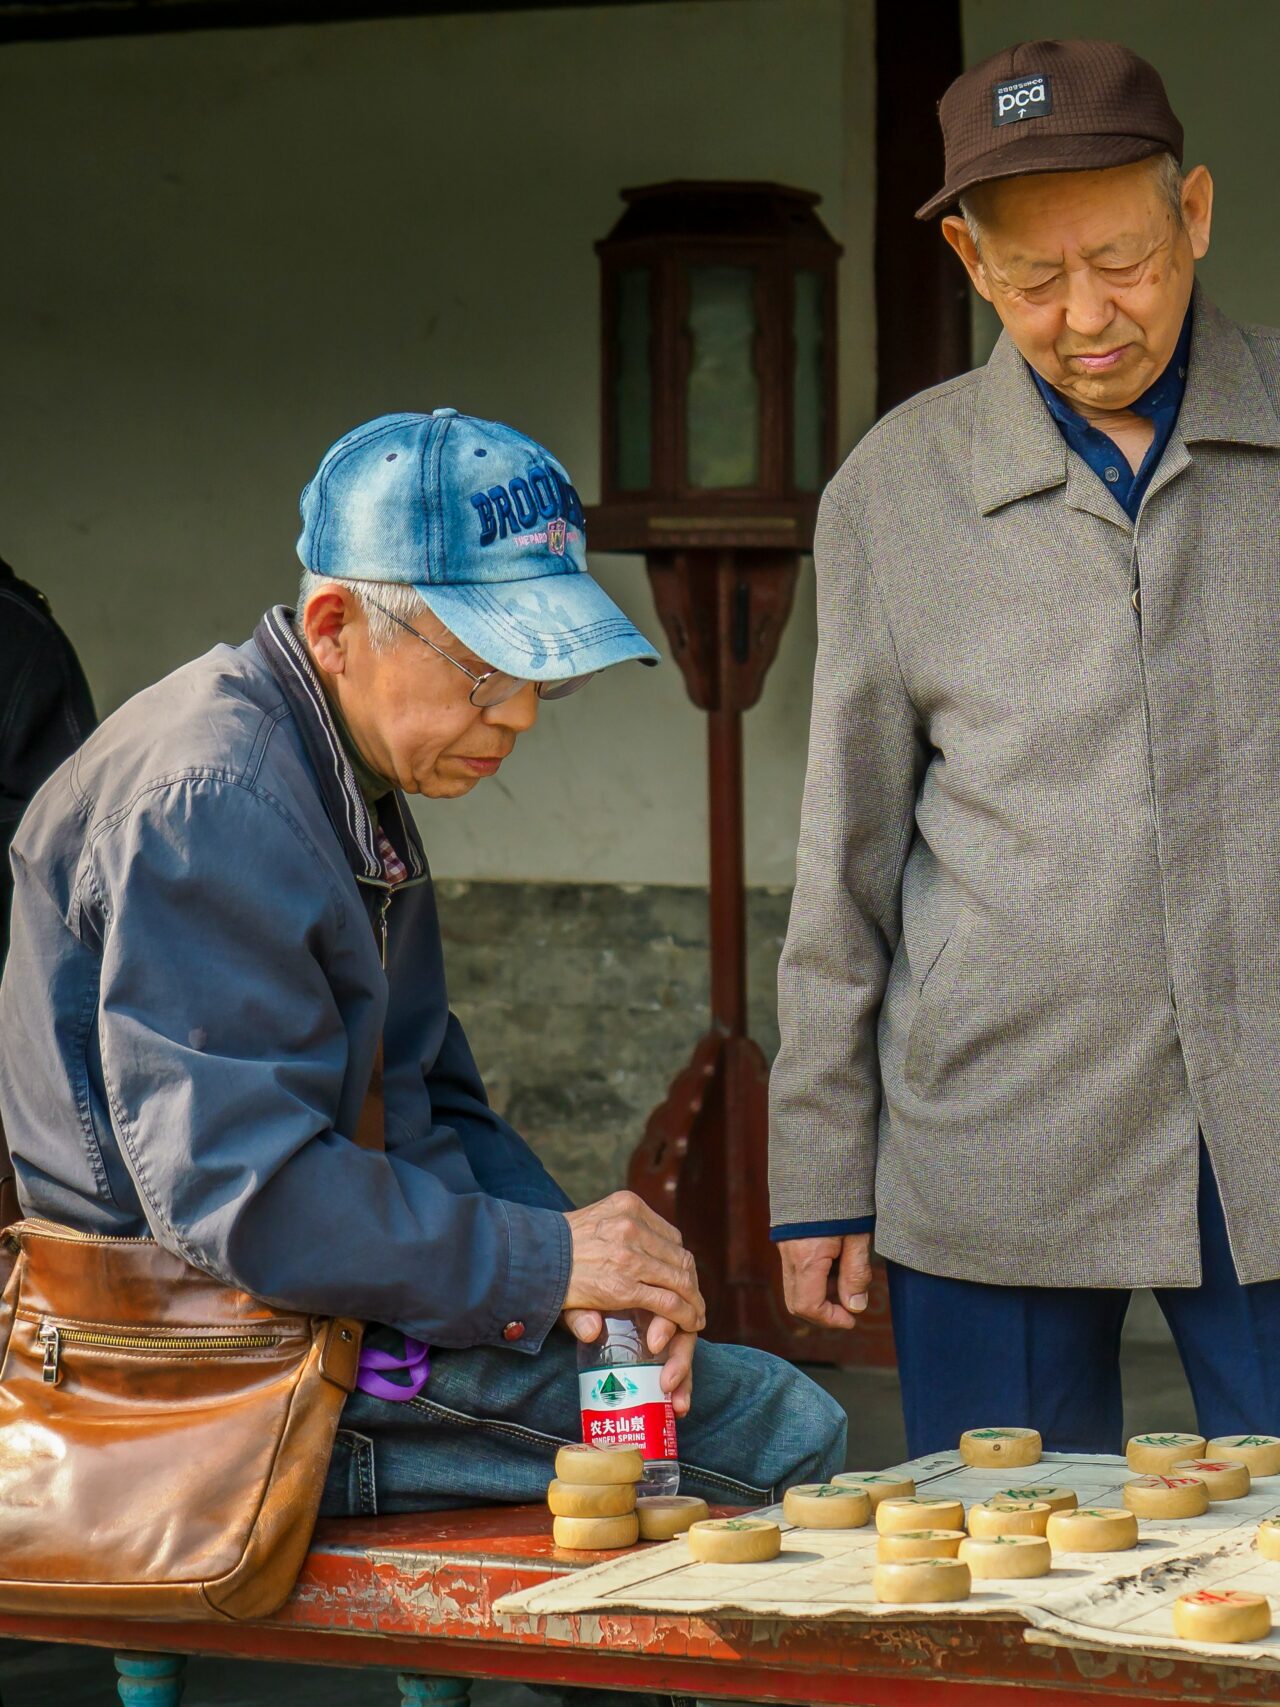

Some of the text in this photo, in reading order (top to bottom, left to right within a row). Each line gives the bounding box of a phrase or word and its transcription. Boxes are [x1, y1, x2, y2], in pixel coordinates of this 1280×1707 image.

[998, 84, 1045, 116] pca
[590, 1416, 644, 1436] 农夫山泉
[617, 1432, 645, 1442] SPRING
